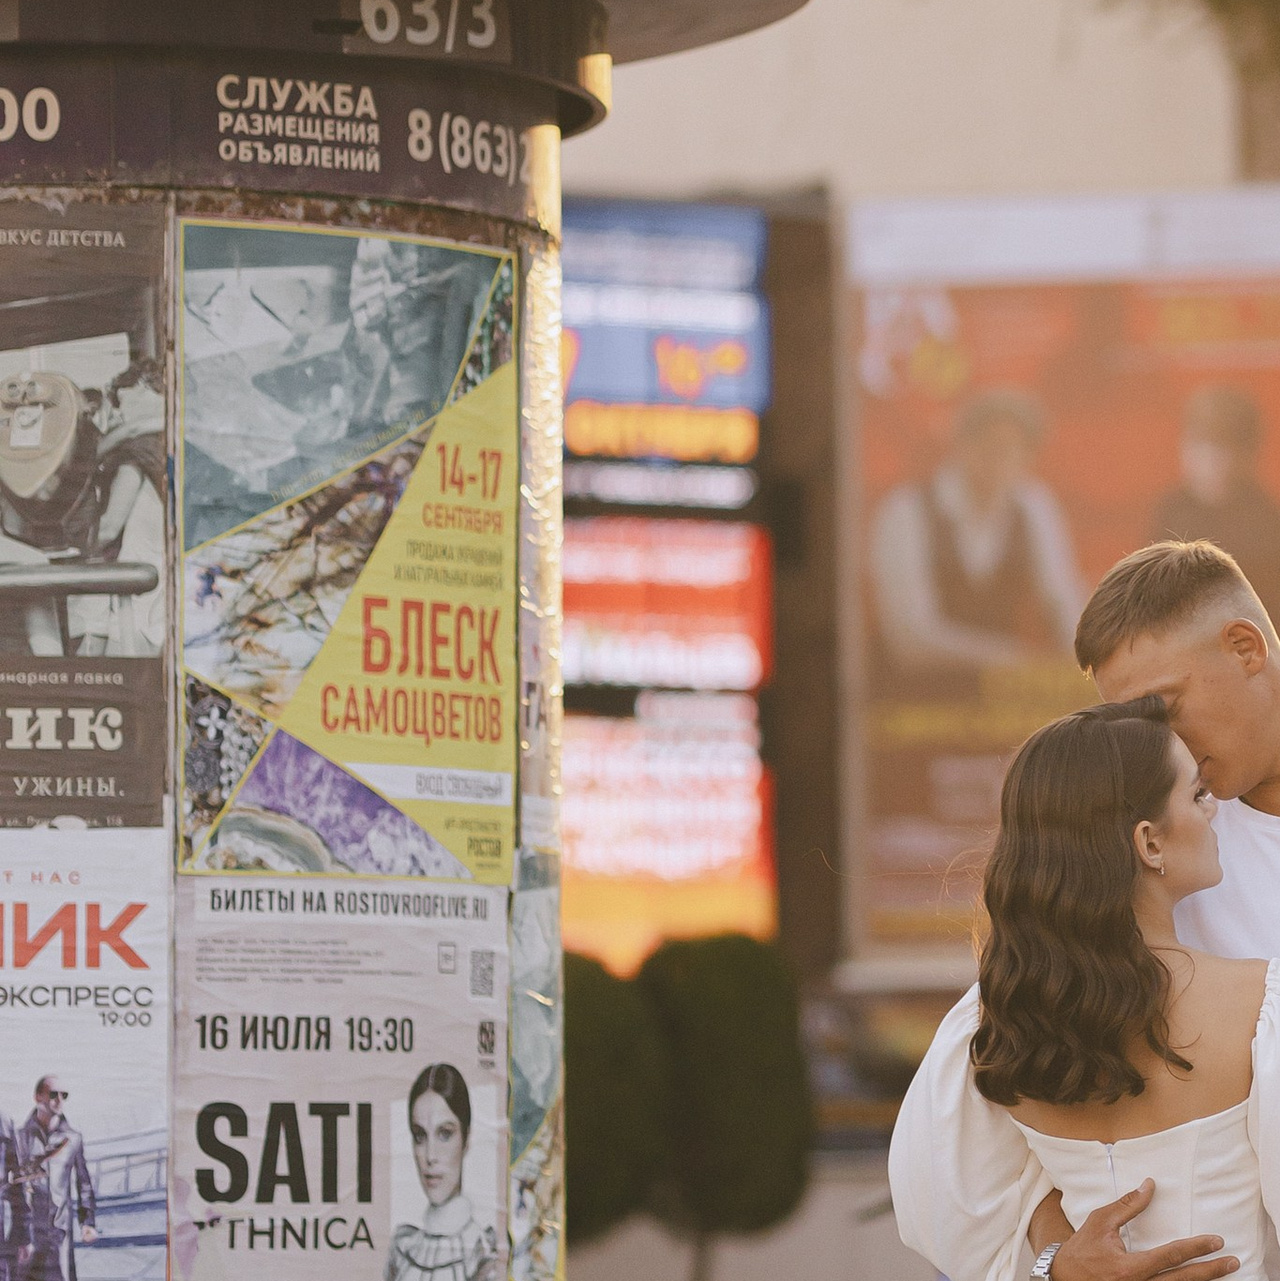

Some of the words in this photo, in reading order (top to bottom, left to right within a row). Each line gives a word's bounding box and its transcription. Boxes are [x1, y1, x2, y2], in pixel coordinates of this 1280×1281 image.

[216, 74, 378, 120] СЛУЖБА
[218, 111, 380, 145] РАЗМЕЩЕНИЯ
[218, 138, 380, 172] ОБЪЯВЛЕНИЙ
[46, 229, 126, 248] ДЕТСТВА
[437, 444, 502, 500] 14-17
[422, 502, 504, 535] СЕНТЯБРЯ
[361, 596, 501, 685] БЛЕСК
[74, 672, 124, 686] лавка
[0, 707, 123, 751] ИК
[321, 684, 502, 748] САМОЦВЕТОВ
[13, 776, 125, 798] УЖИНЫ.
[31, 871, 81, 885] НАС
[210, 888, 295, 913] БИЛЕТЫ
[302, 891, 327, 913] НА
[334, 891, 488, 920] ROSTOVROOFLIVE.RU
[0, 902, 150, 969] ИК
[100, 1011, 152, 1028] 19:00
[197, 1015, 229, 1051] 16
[240, 1015, 331, 1051] ИЮЛЯ
[346, 1017, 414, 1052] 19:30
[195, 1101, 373, 1204] SATI
[194, 1216, 374, 1251] THNICA
